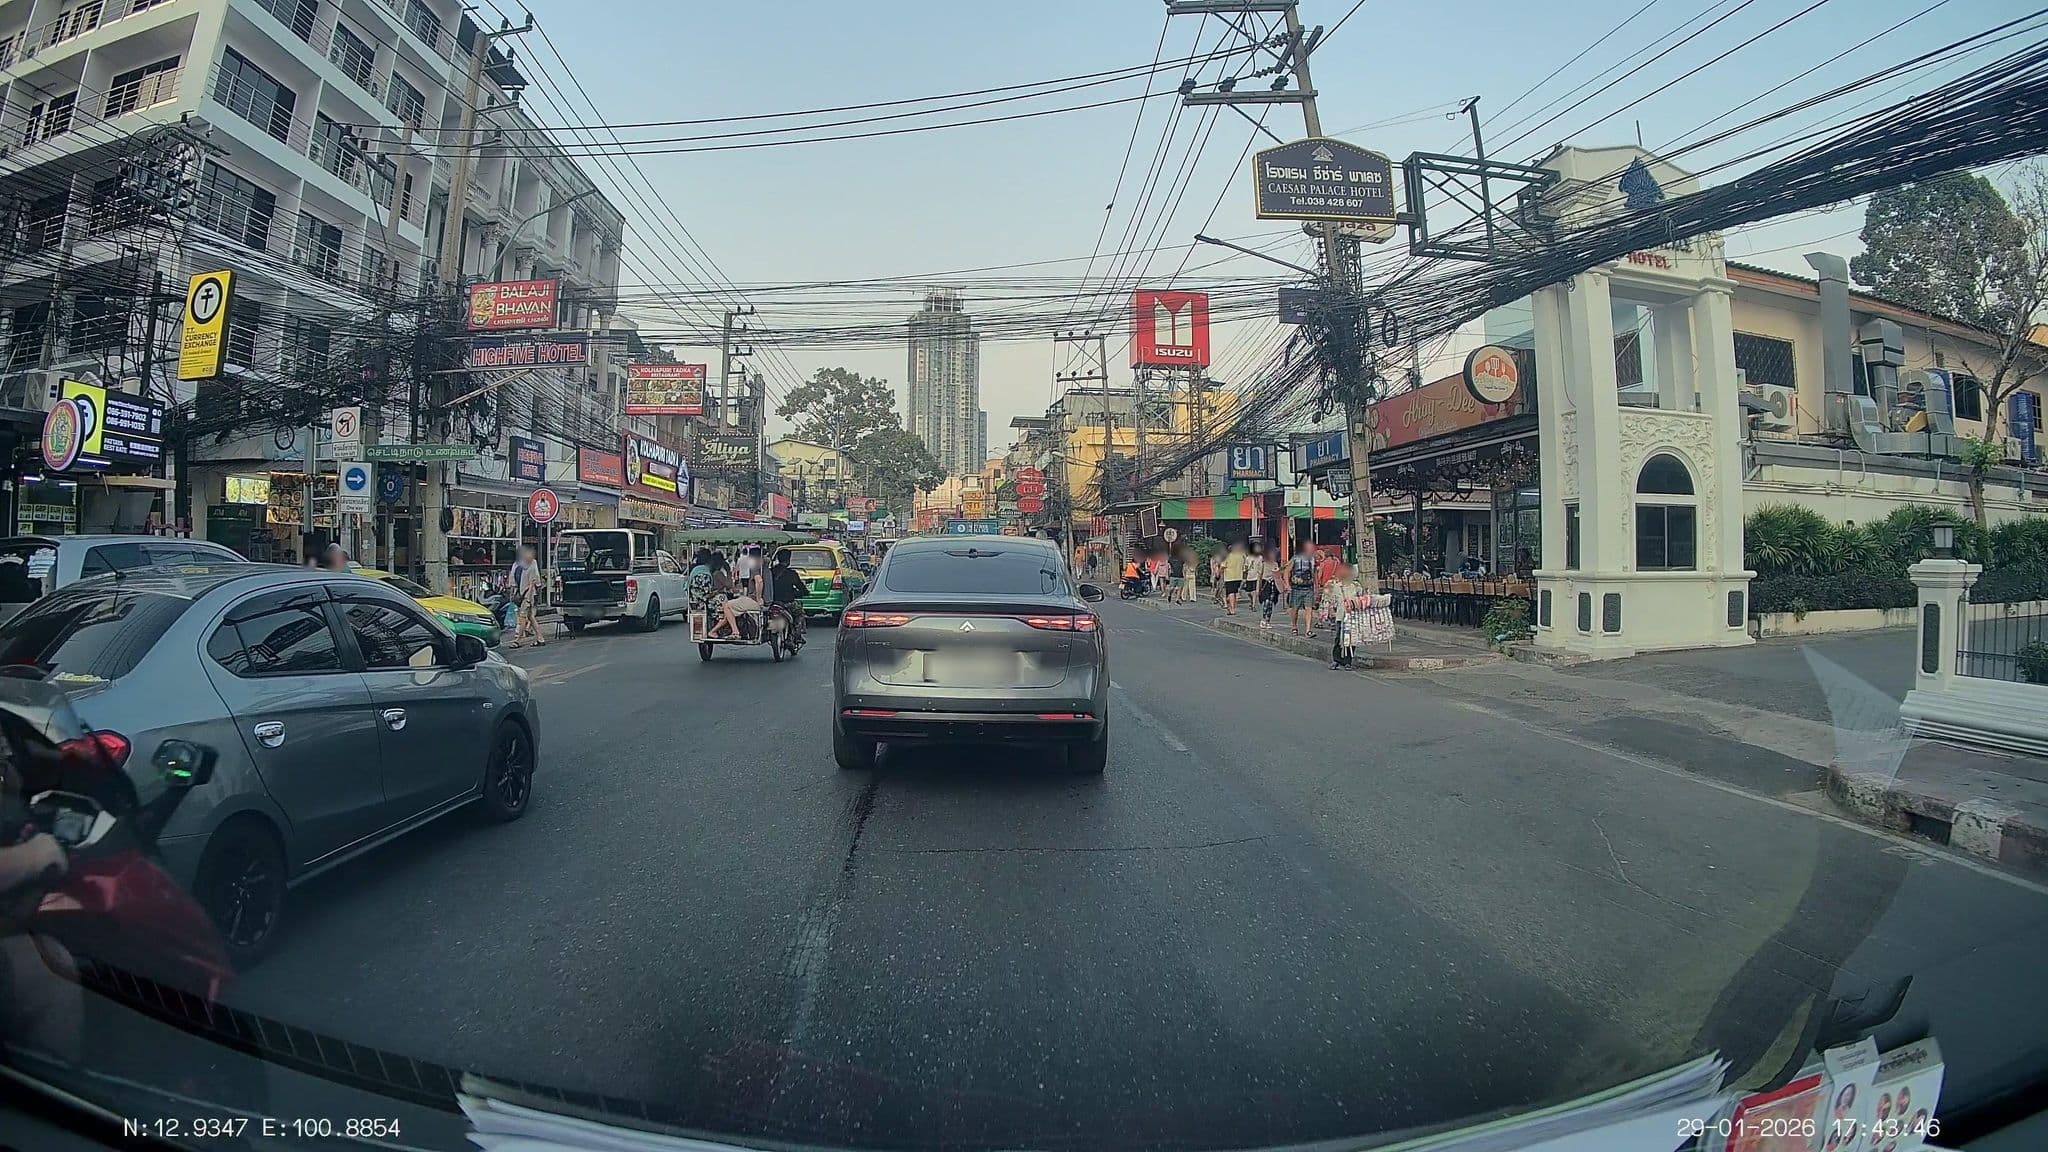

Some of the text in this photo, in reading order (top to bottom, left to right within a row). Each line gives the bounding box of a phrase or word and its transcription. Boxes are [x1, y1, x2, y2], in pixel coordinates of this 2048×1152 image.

[1266, 162, 1307, 180] โรงแรม
[1312, 166, 1343, 181] ซีซ่าร์
[1268, 182, 1384, 198] CAESAR PALACE HOTEL
[1290, 196, 1363, 208] Tel.038 428 607
[1627, 251, 1672, 268] HOTEL
[500, 284, 550, 298] BALAJI
[496, 300, 551, 316] BHAVAN
[184, 332, 218, 342] CURRENCY
[184, 338, 217, 350] EXCHANGE
[472, 342, 586, 366] HIGHFIVE HOTEL
[1156, 348, 1192, 357] ISUZU
[700, 442, 751, 459] Aliya
[1318, 440, 1330, 457] ยา
[1234, 446, 1264, 470] ยา
[1312, 454, 1339, 466] PHARMACY
[1233, 470, 1266, 478] PHARMACY
